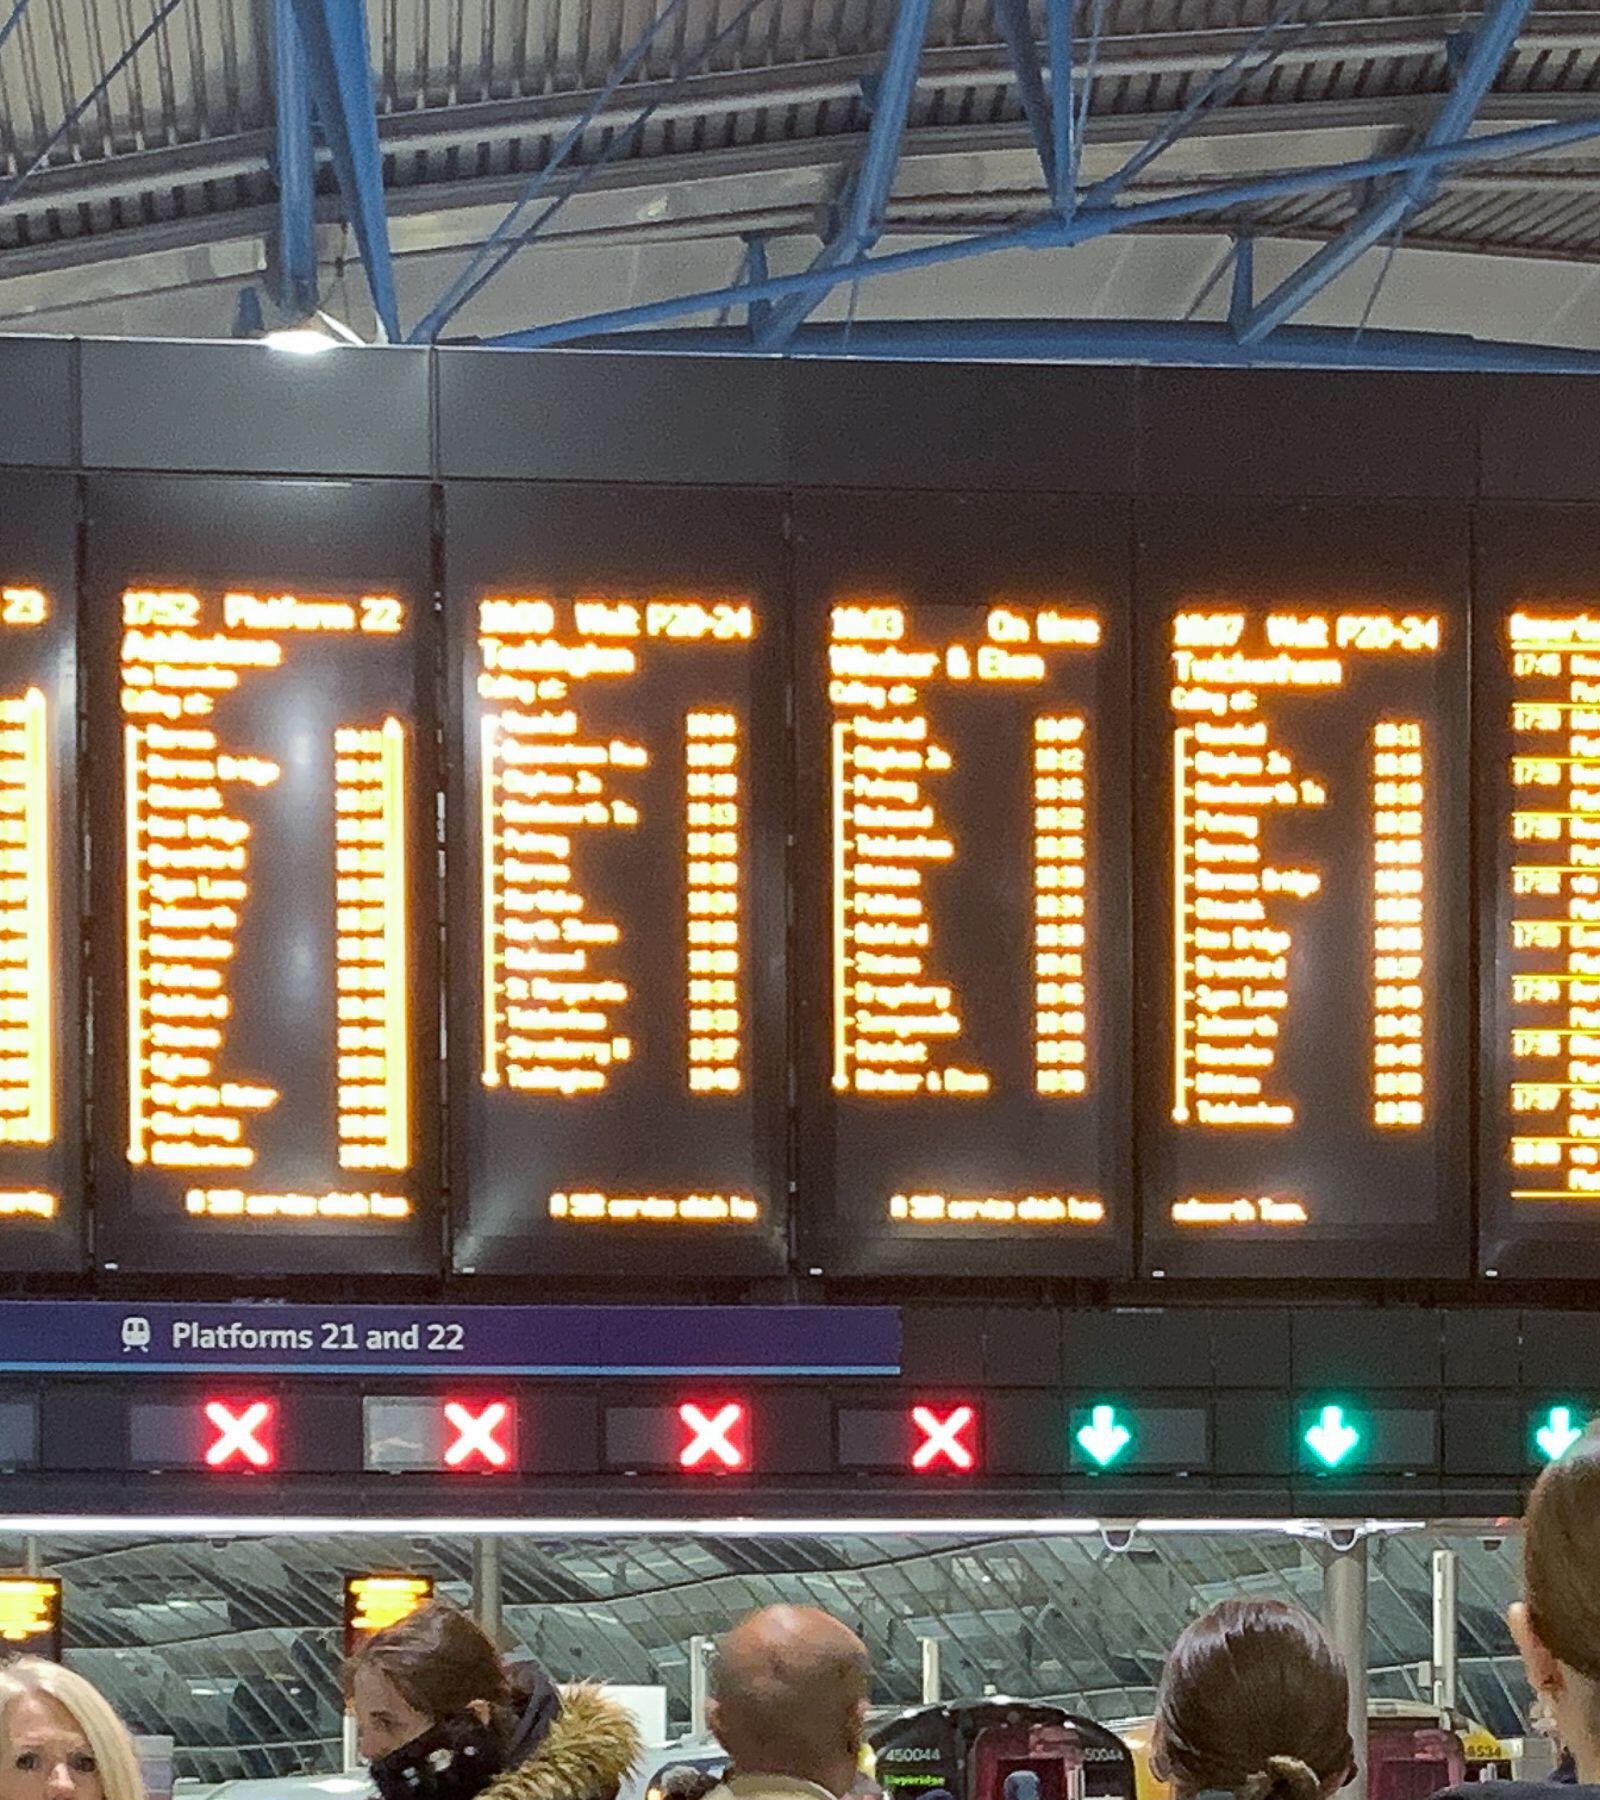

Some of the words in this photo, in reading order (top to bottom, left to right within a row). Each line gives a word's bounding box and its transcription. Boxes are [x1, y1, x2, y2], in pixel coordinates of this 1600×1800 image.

[173, 1321, 314, 1349] Platforms
[320, 1323, 358, 1349] 21
[366, 1323, 419, 1350] and
[427, 1324, 465, 1350] 22
